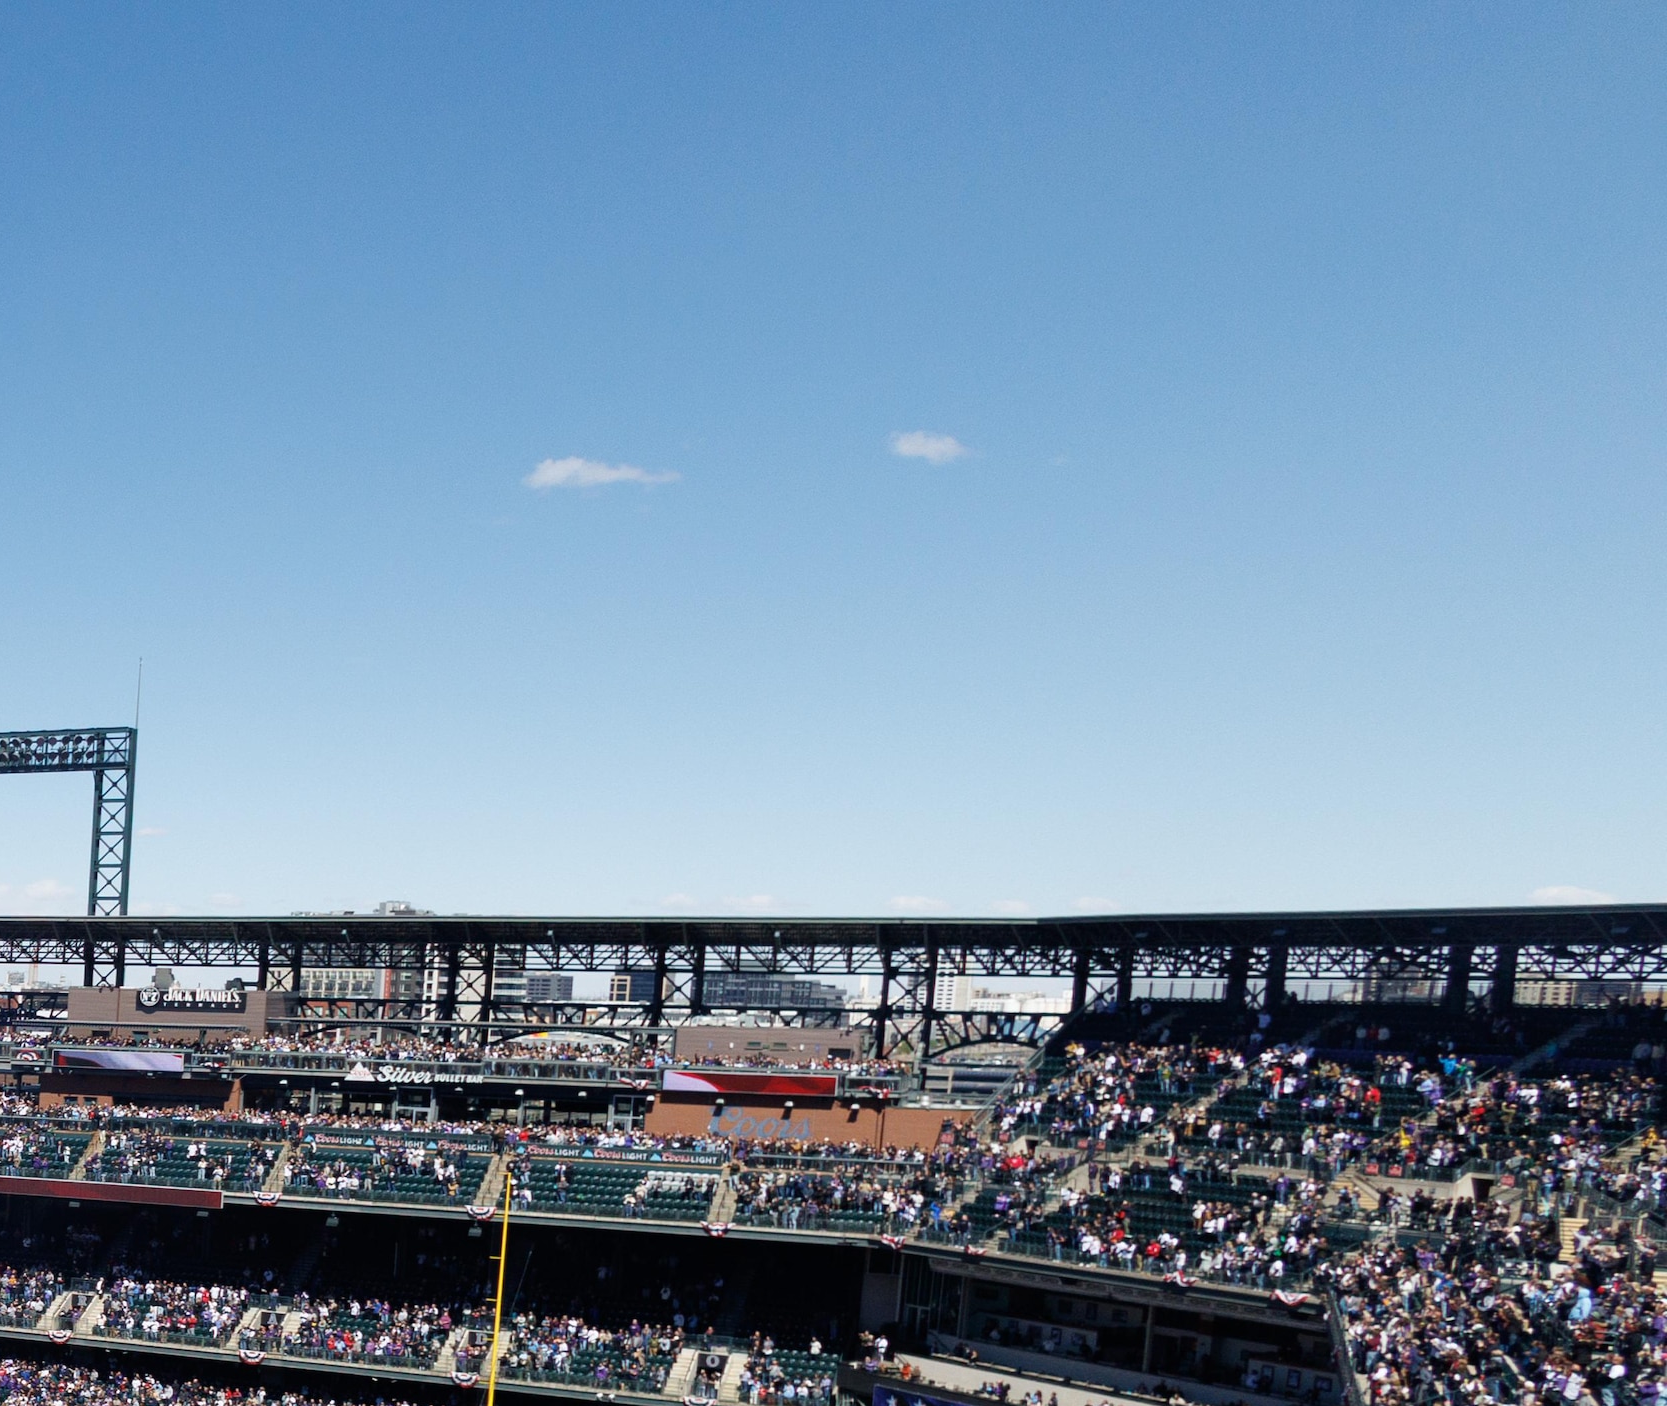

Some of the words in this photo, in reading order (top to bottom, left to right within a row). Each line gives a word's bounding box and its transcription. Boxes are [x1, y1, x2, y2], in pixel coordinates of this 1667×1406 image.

[163, 988, 193, 1001] JACK
[377, 1066, 432, 1084] Silver
[466, 1075, 483, 1084] BAR
[709, 1106, 810, 1138] Coors
